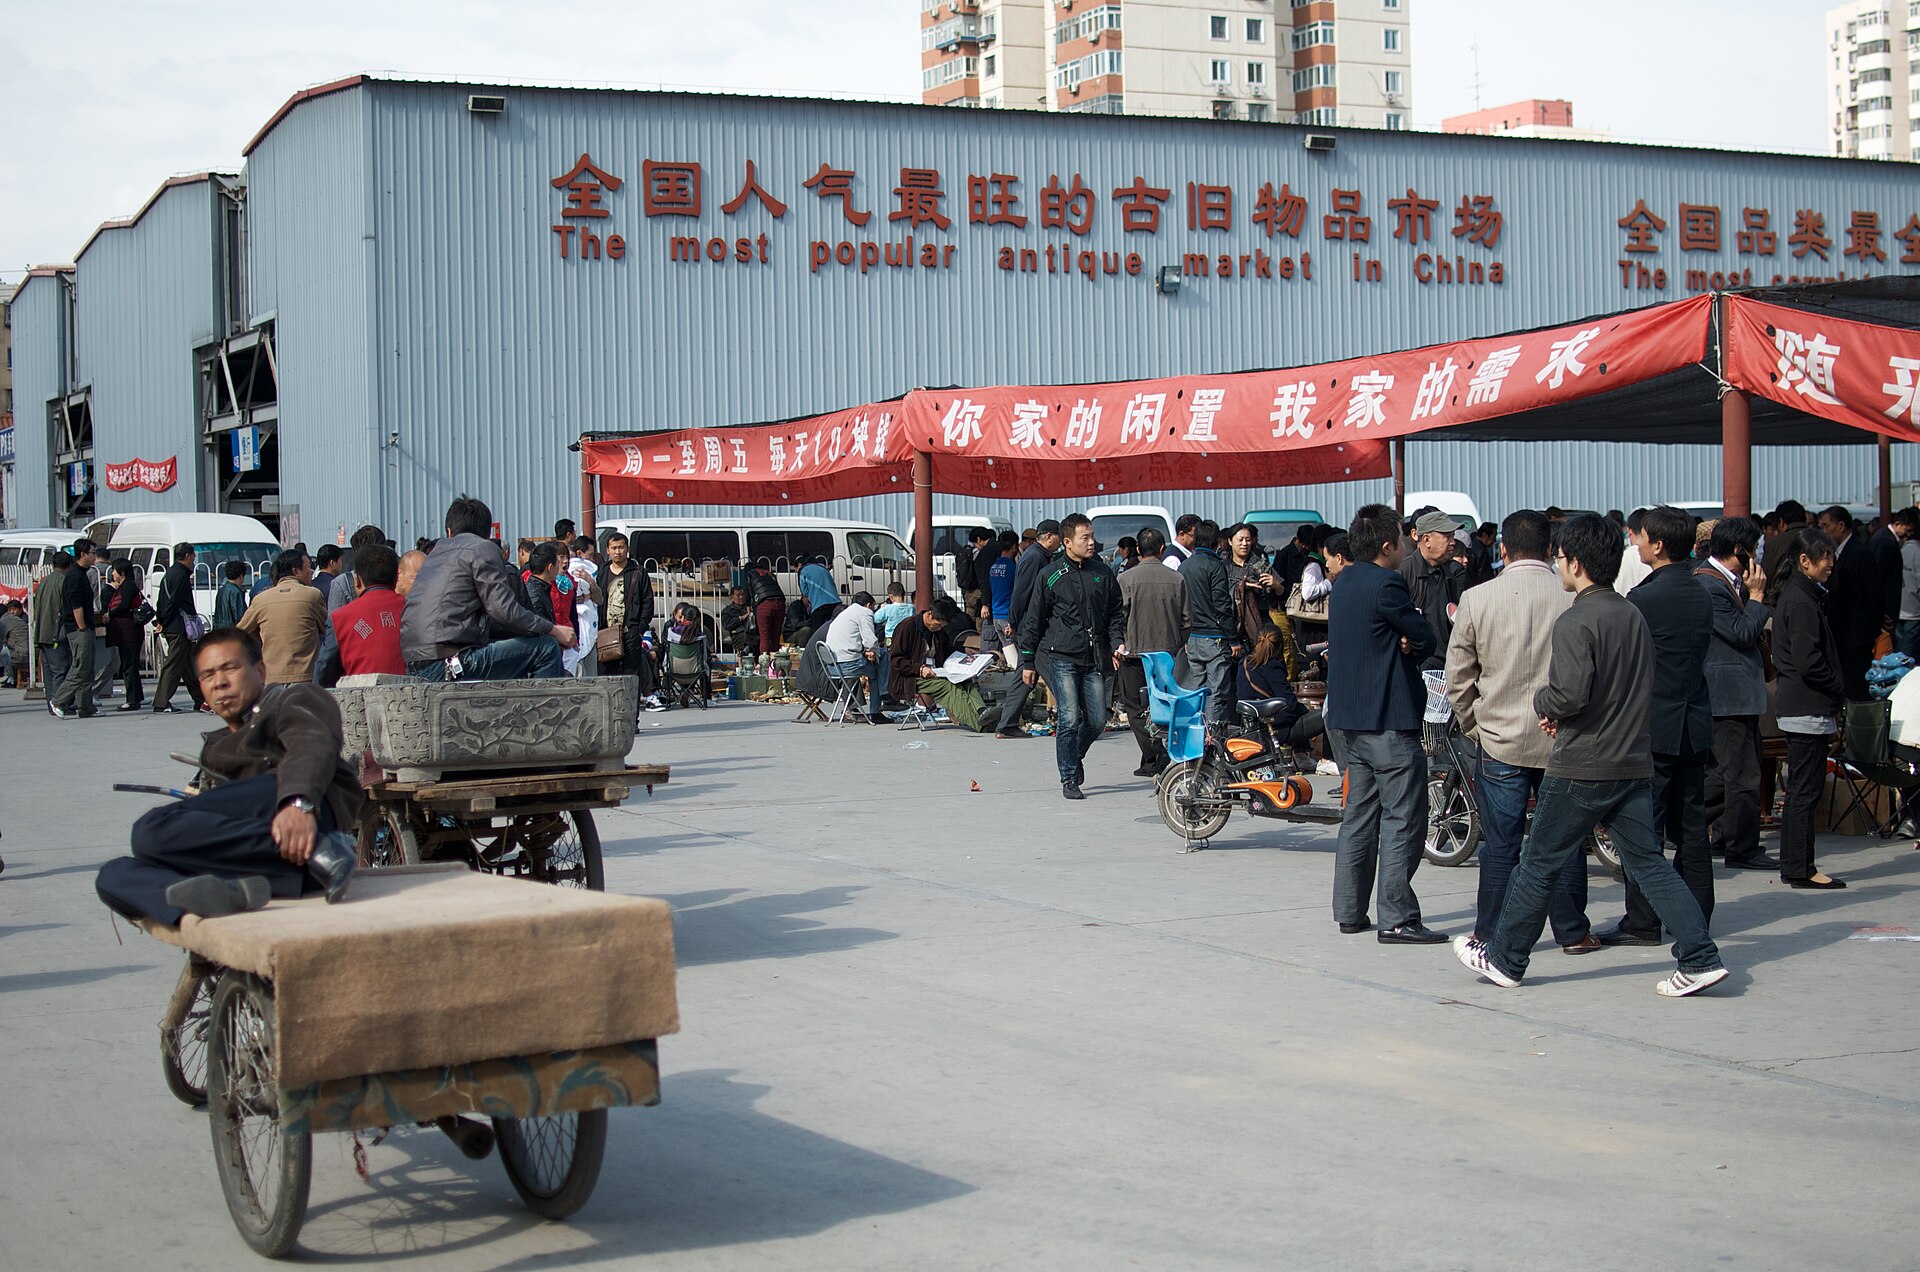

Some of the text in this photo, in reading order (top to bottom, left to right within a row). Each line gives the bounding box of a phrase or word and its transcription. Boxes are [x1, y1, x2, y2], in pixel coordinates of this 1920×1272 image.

[551, 152, 1503, 248] 全国人气最旺的古旧物品市场
[552, 225, 1504, 284] The most popular antique market in China
[1618, 260, 1667, 289] The
[1686, 267, 1751, 290] most
[941, 327, 1600, 449] 你家的闲置 我家的需求
